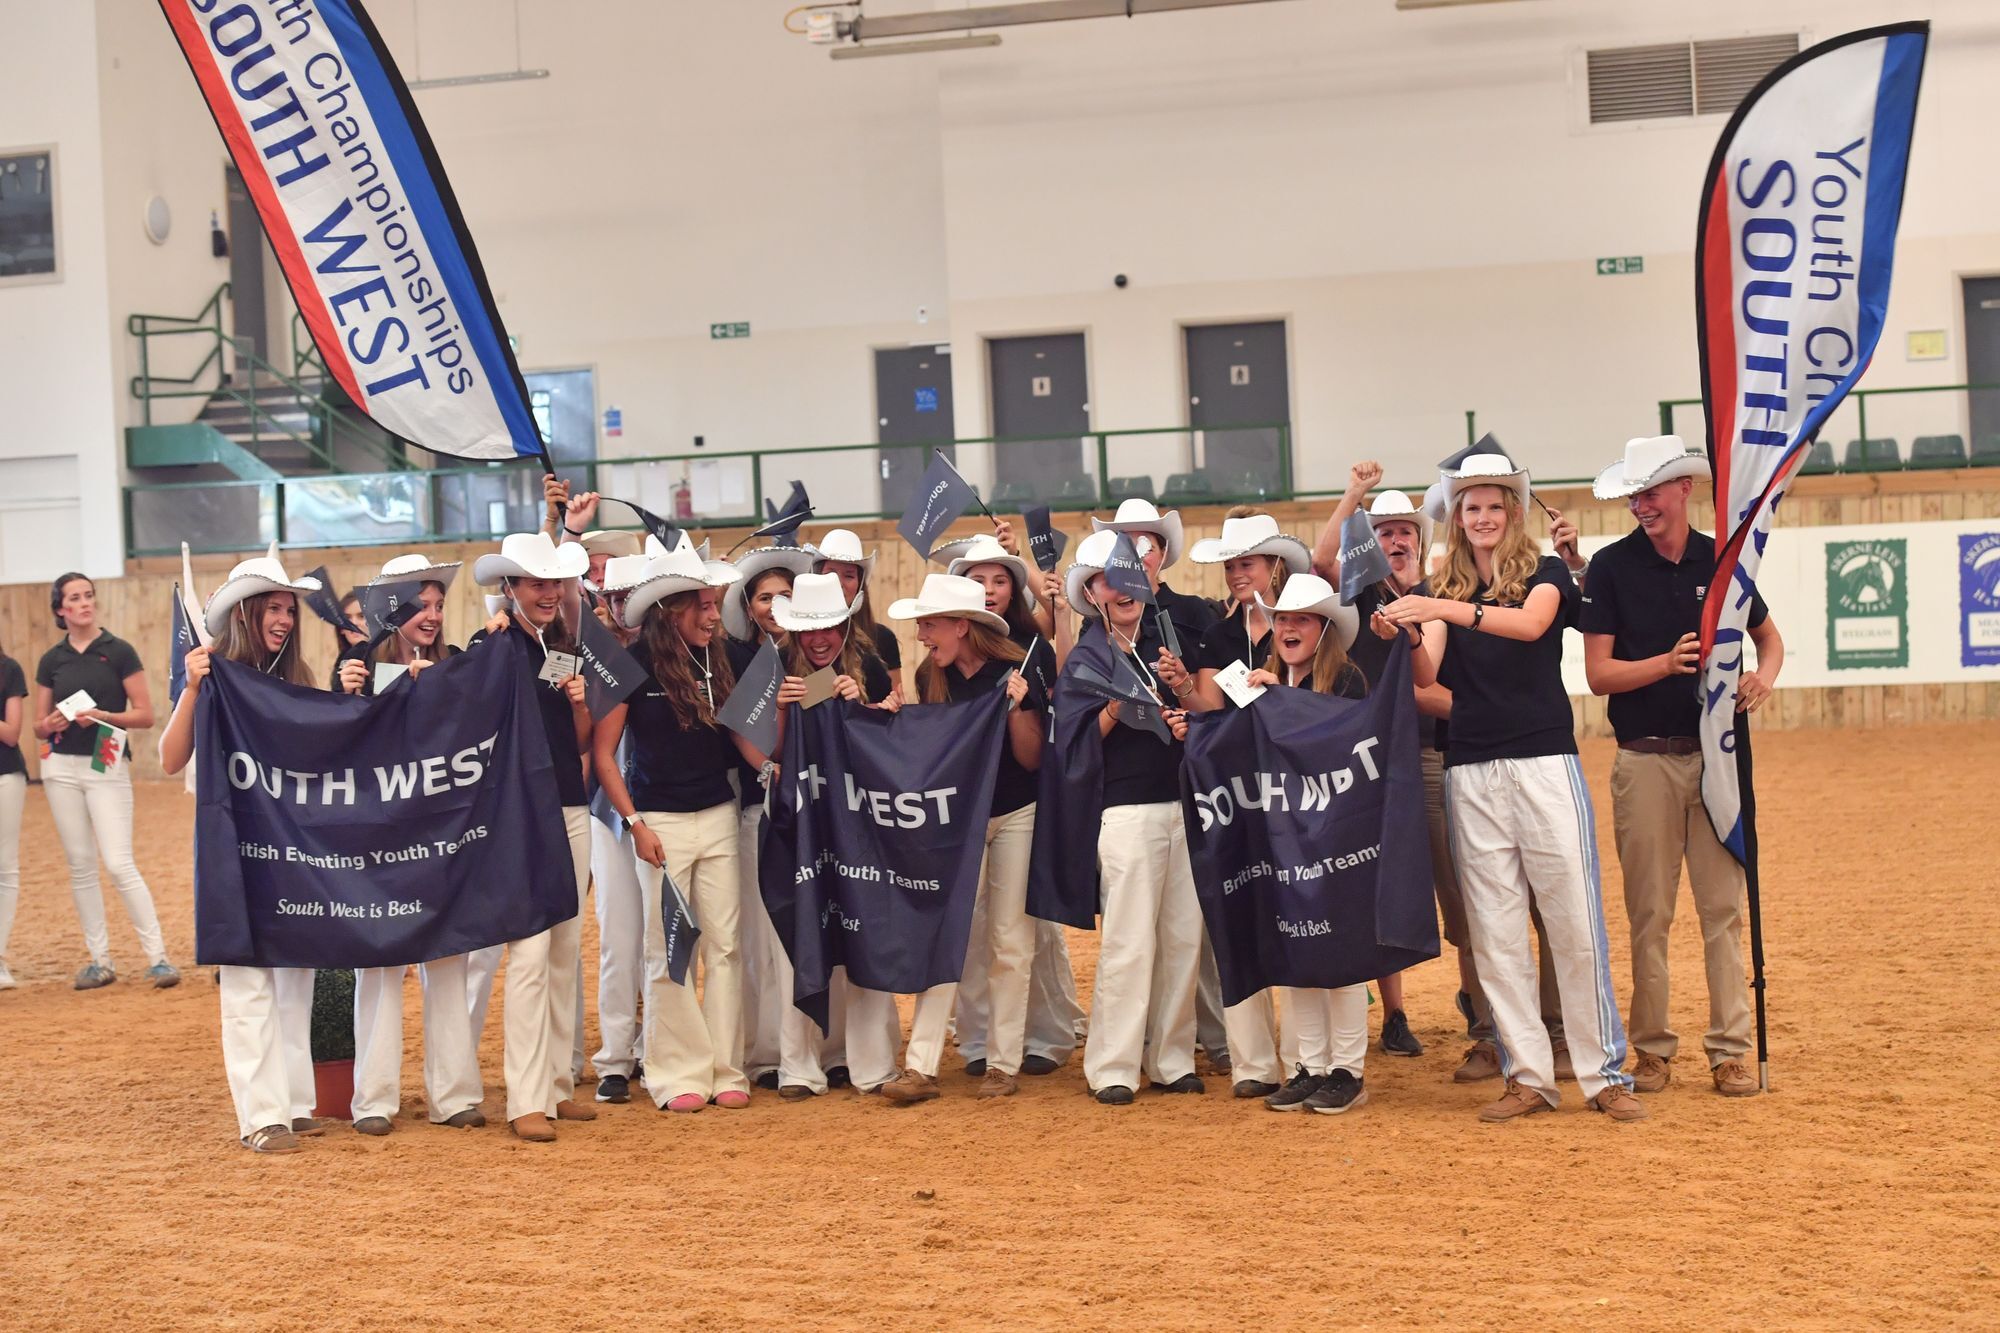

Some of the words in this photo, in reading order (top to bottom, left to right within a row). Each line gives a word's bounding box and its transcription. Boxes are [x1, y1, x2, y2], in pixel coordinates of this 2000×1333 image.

[304, 52, 473, 395] Championships
[1807, 137, 1866, 301] Youth
[303, 197, 431, 397] WEST
[1736, 158, 1796, 447] SOUTH
[1830, 543, 1873, 572] SKERNE
[1874, 544, 1902, 568] LEYS
[593, 660, 619, 688] WEST
[228, 751, 356, 806] OUTH
[373, 733, 499, 802] WEST
[1194, 772, 1290, 832] SOUH
[238, 841, 279, 861] itish
[285, 846, 366, 871] Eventing
[369, 844, 429, 865] Youth
[886, 869, 940, 891] Teams
[1223, 860, 1272, 896] British
[1294, 861, 1324, 881] Youth
[276, 898, 324, 917] South
[329, 901, 366, 918] West
[369, 903, 382, 918] is
[387, 899, 422, 917] Best
[1307, 920, 1332, 936] Best
